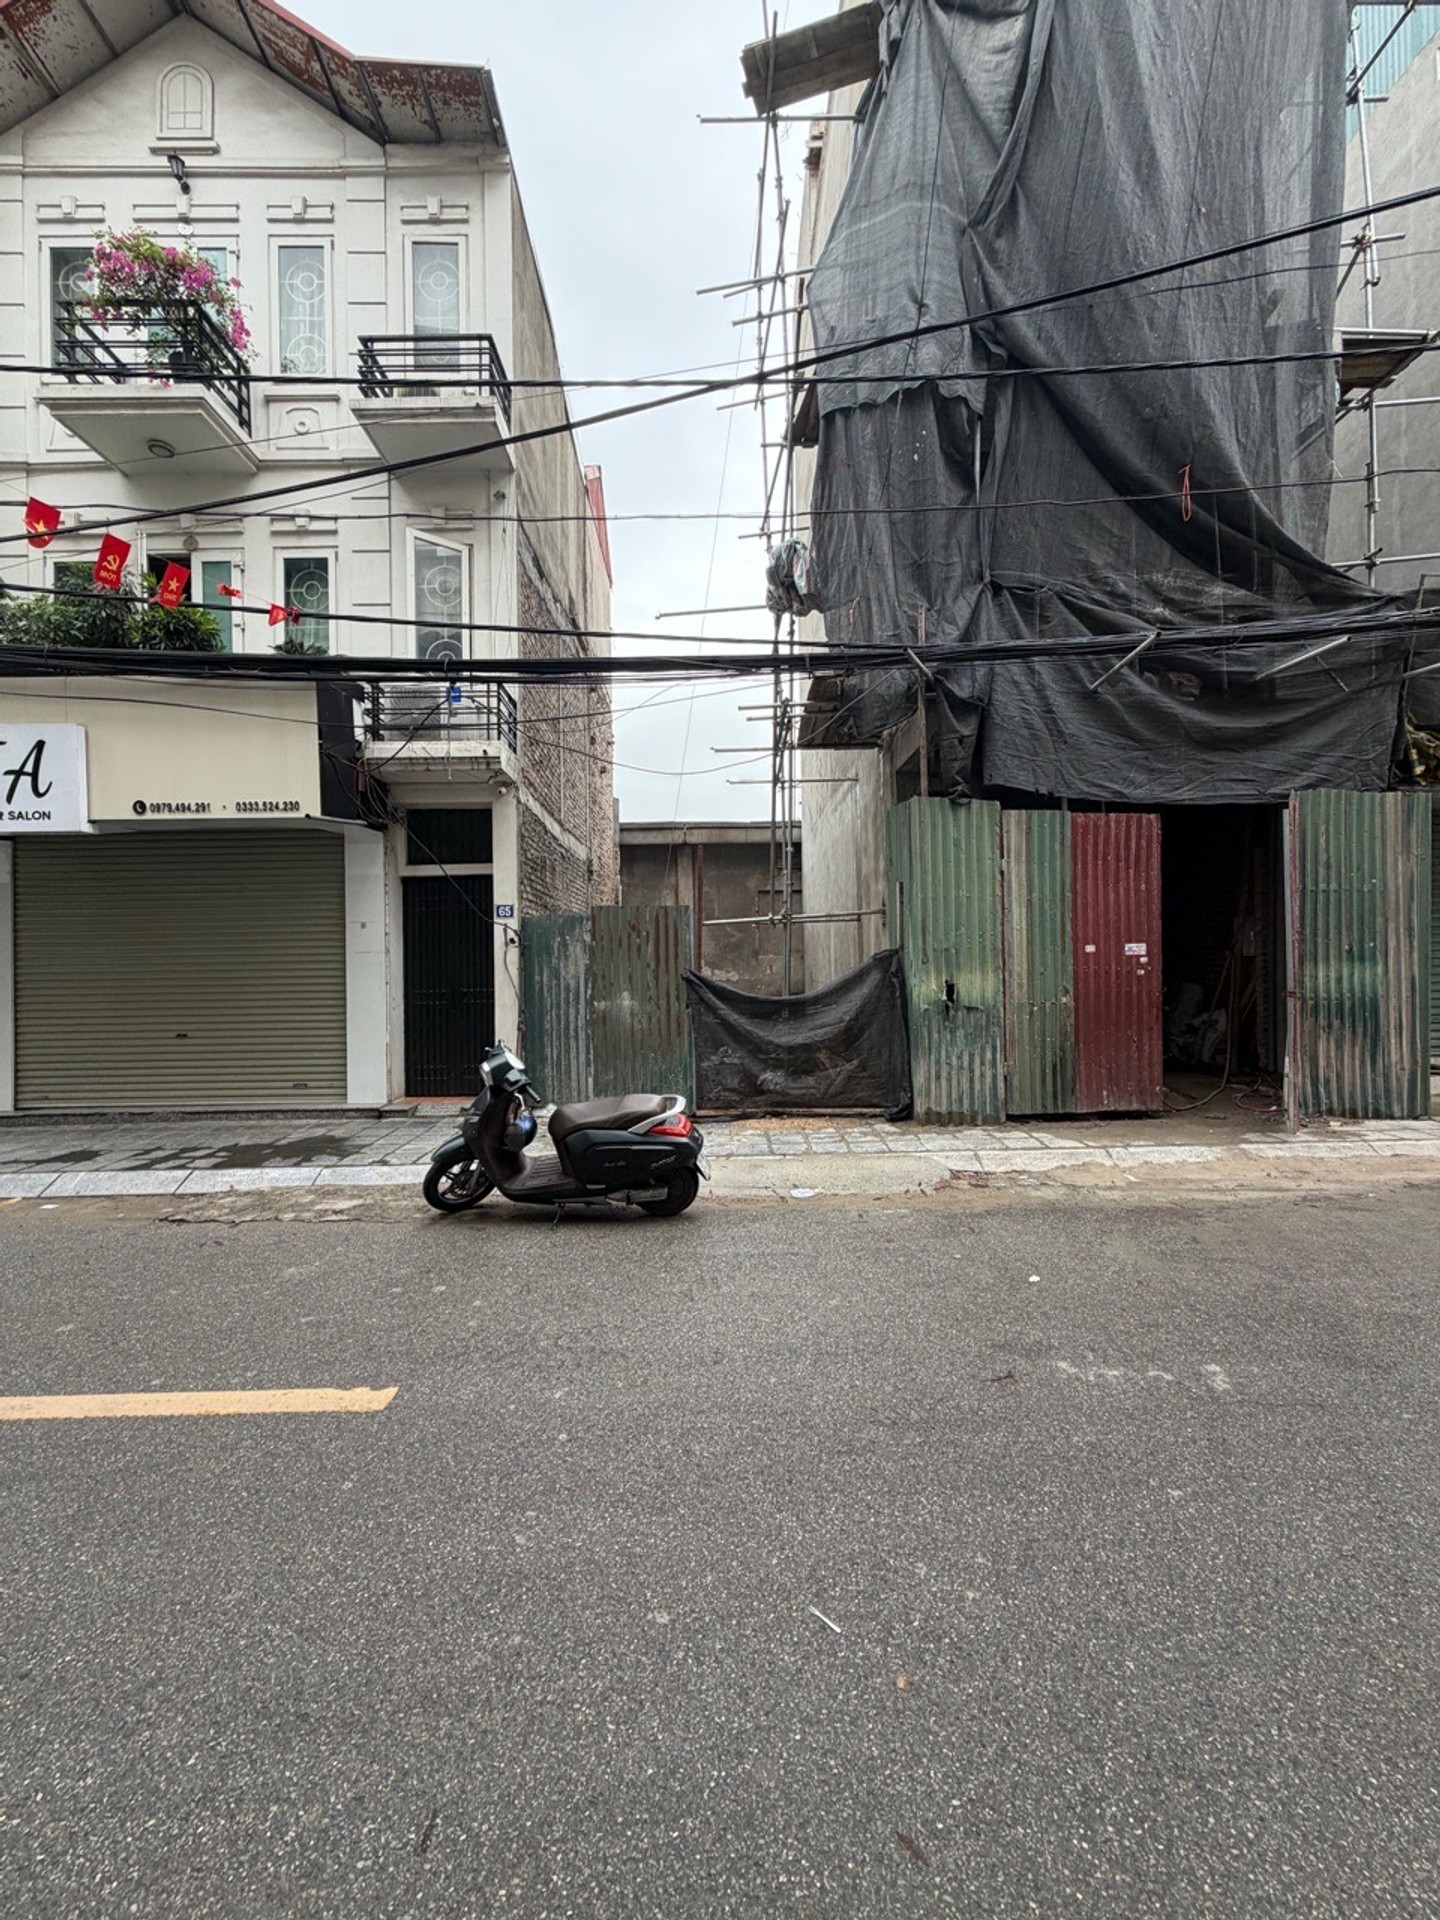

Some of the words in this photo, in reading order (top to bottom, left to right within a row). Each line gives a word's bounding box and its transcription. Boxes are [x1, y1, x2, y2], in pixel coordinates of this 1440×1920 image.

[0, 739, 53, 805] A
[149, 802, 212, 813] 0979.494.291
[235, 801, 300, 812] 0333.524.230
[7, 810, 52, 820] SALON
[498, 905, 512, 916] 65
